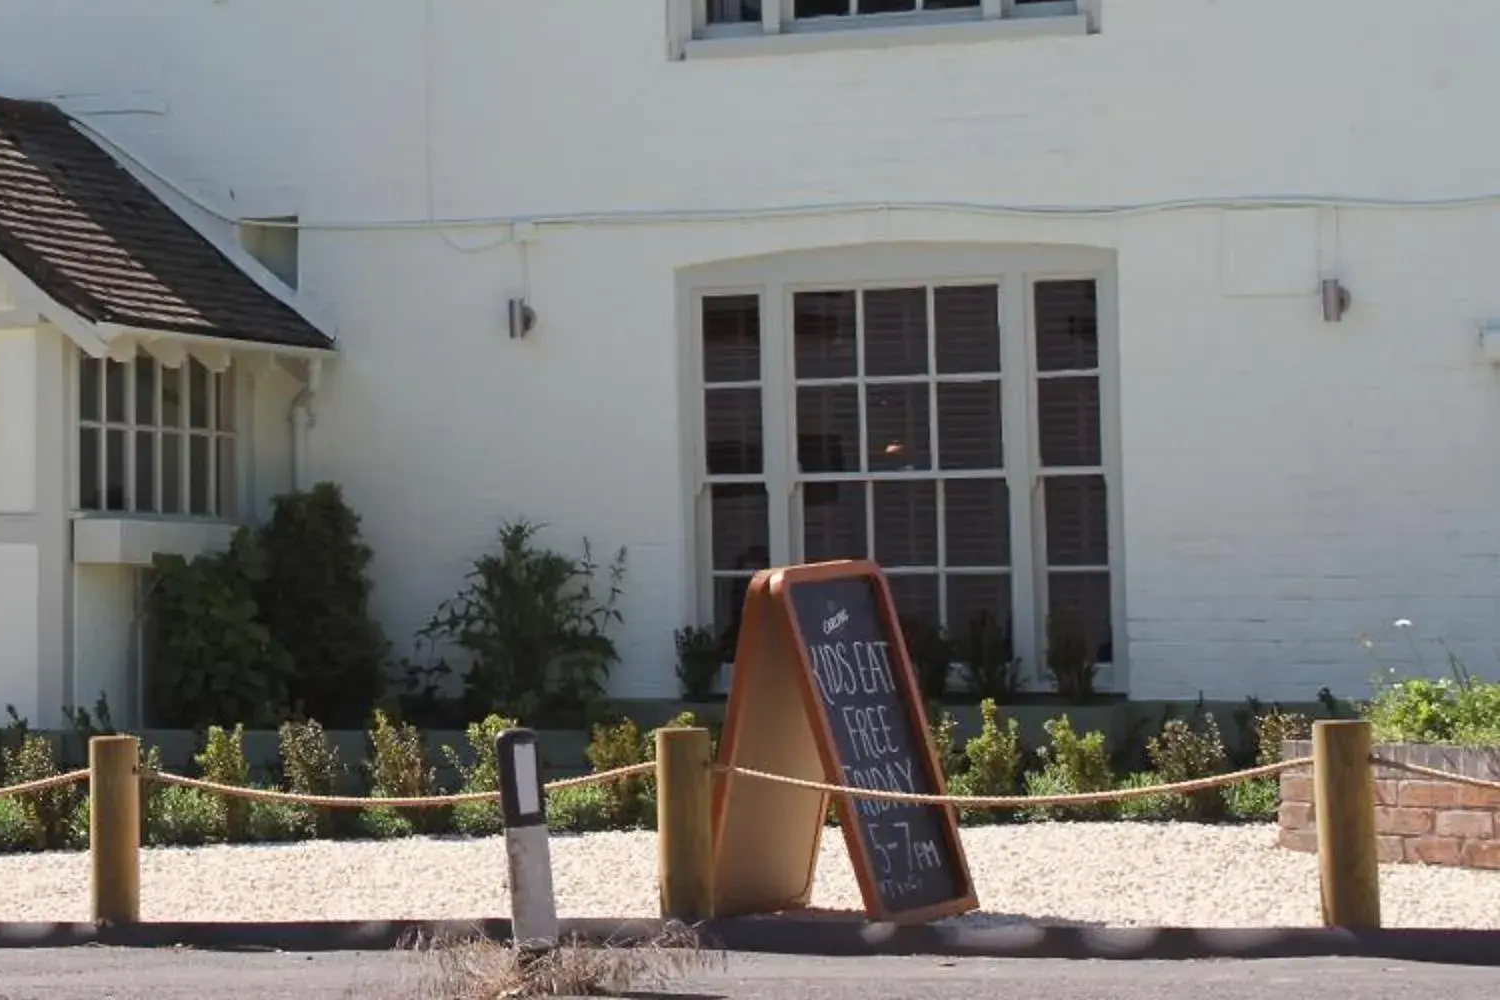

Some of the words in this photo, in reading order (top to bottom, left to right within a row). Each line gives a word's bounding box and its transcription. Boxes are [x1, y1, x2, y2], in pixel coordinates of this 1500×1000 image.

[810, 641, 857, 706] KIDS
[853, 640, 896, 695] EAT
[841, 704, 900, 761] FREE
[840, 759, 918, 816] FRIDAY
